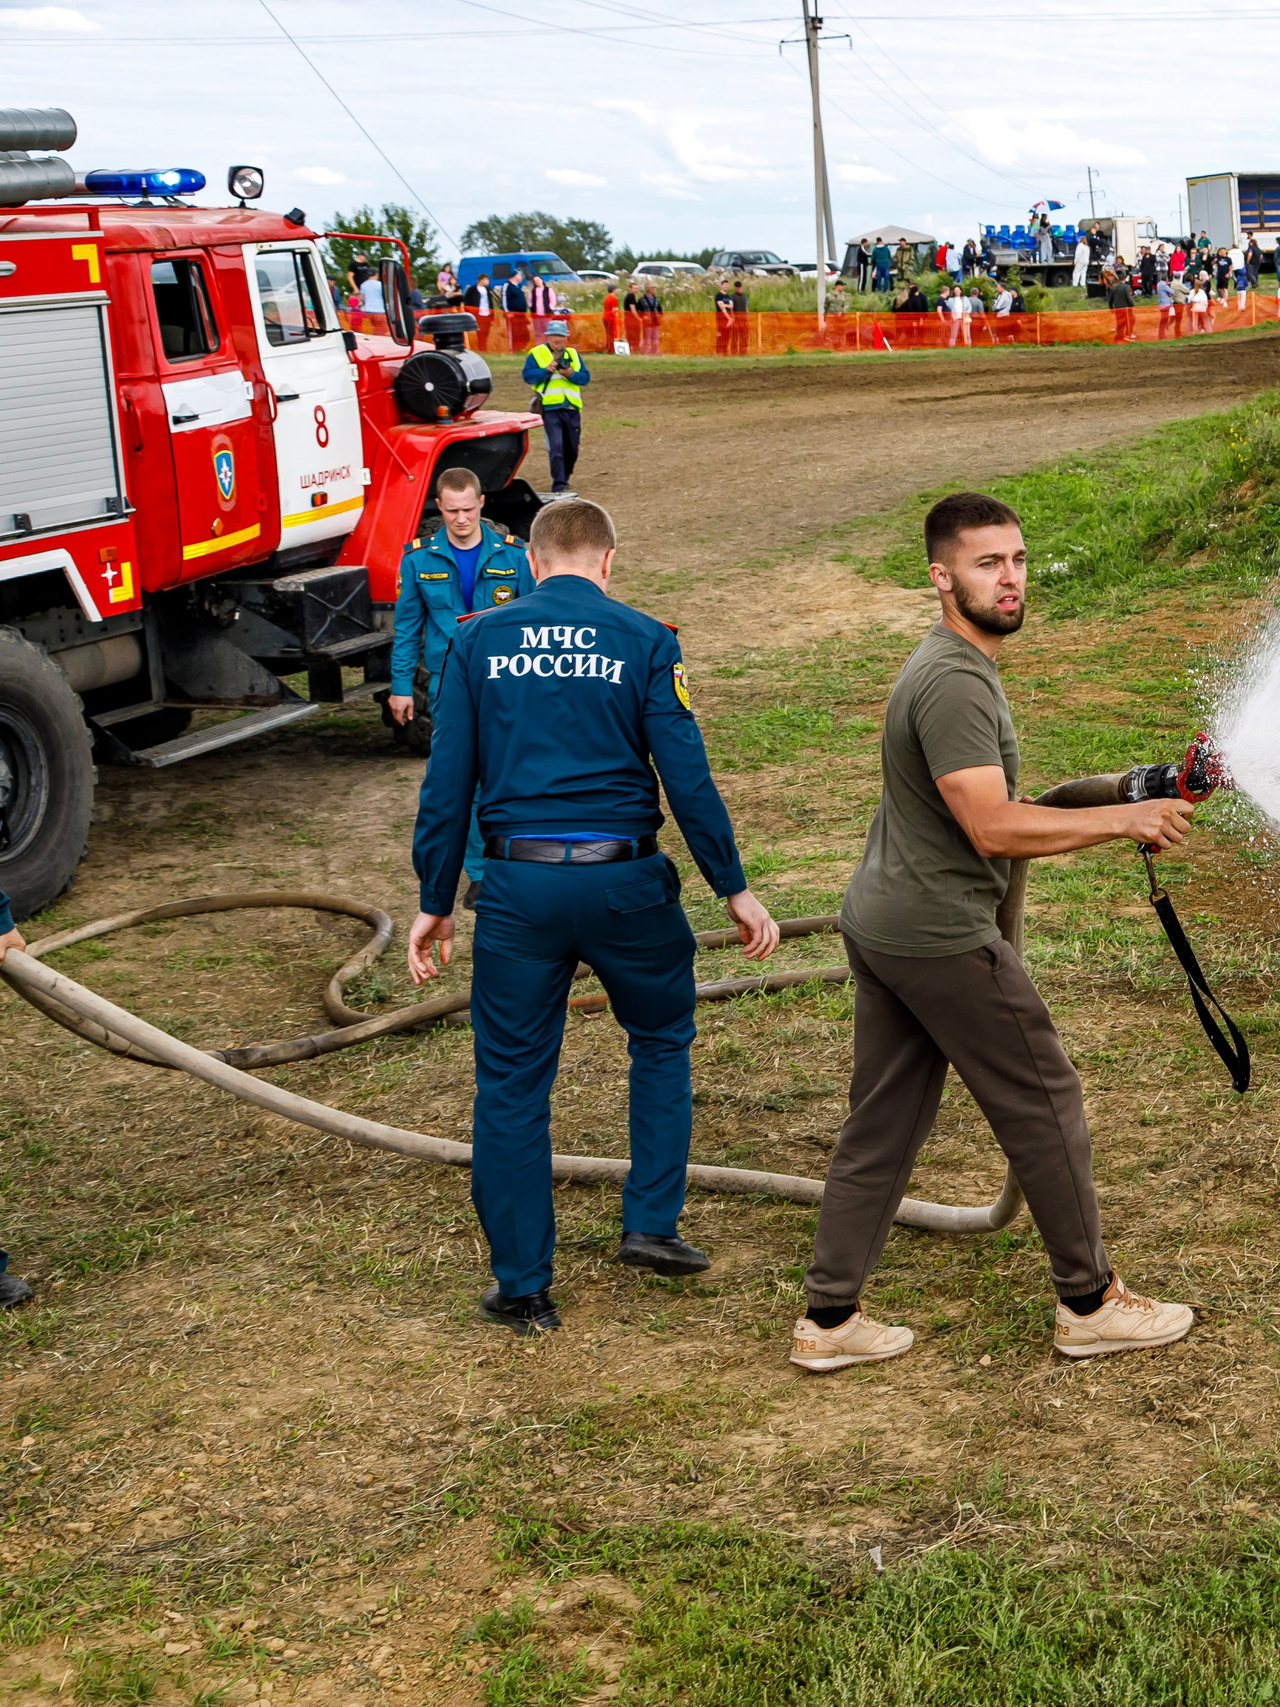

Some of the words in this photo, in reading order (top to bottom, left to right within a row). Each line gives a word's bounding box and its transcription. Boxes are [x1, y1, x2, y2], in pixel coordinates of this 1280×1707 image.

[313, 404, 329, 449] 8
[300, 464, 351, 489] ШАДРИНСК
[519, 625, 597, 649] МЧС
[487, 653, 626, 685] РОССИИ
